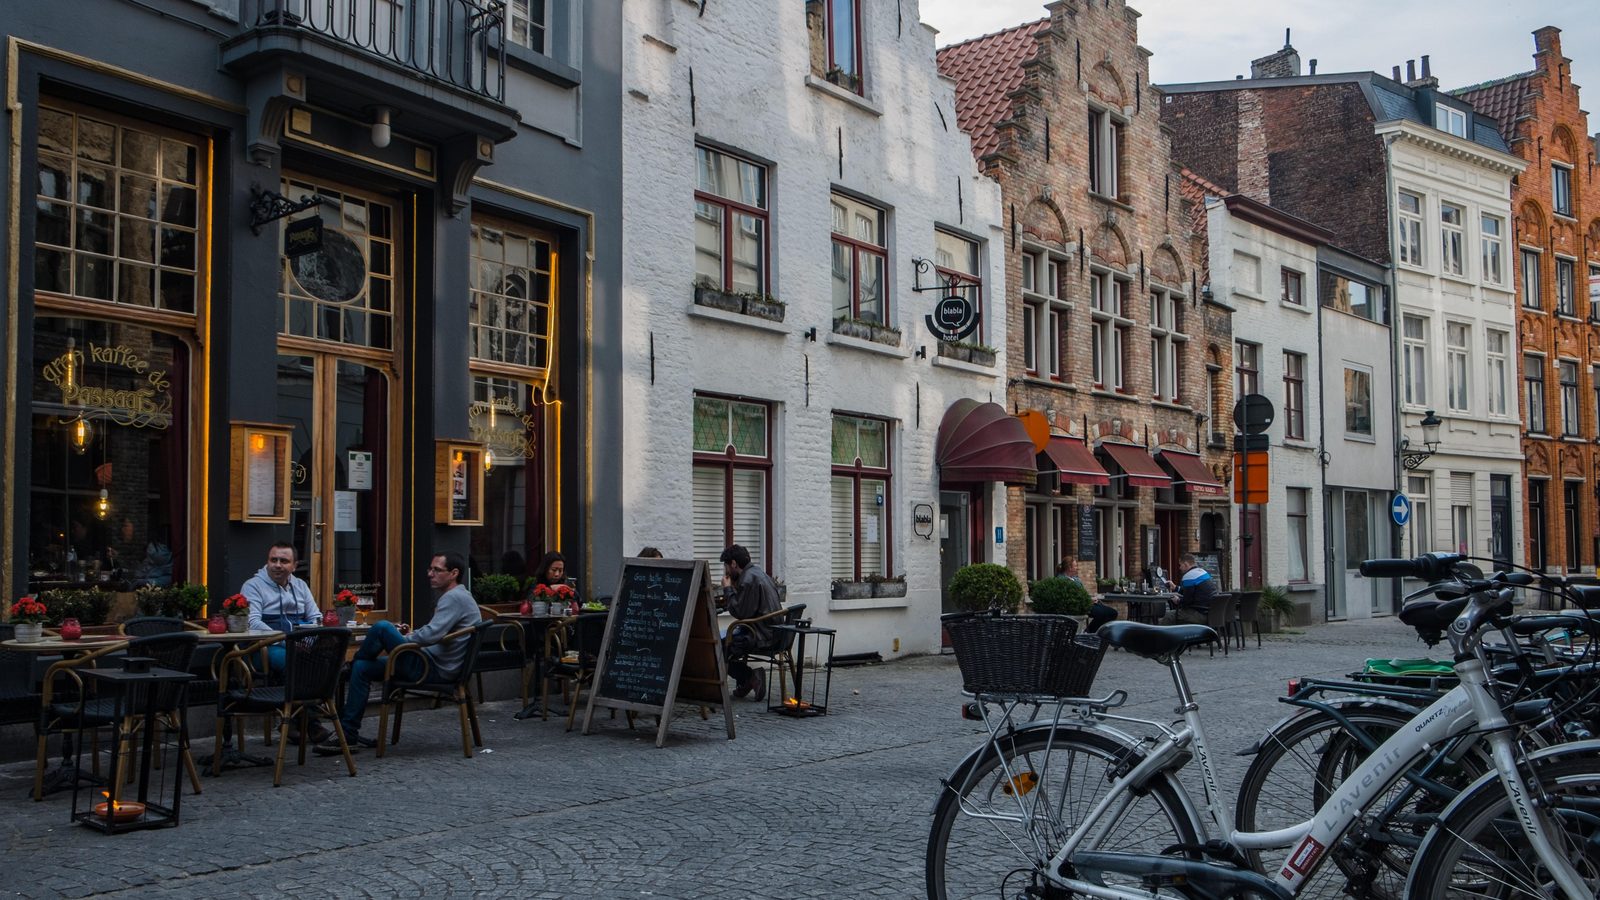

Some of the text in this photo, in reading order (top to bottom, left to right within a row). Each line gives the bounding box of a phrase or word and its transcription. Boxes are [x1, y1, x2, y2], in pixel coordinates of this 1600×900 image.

[943, 303, 962, 315] blabla
[942, 333, 959, 341] hotel
[88, 342, 148, 374] kaffee
[148, 370, 170, 392] de
[522, 414, 535, 431] de
[916, 514, 931, 523] blabla
[1415, 708, 1444, 732] QUARTZ
[1197, 745, 1217, 793] L'Avenir
[1324, 747, 1401, 832] L'Avenir
[1508, 779, 1537, 836] L'Avenir
